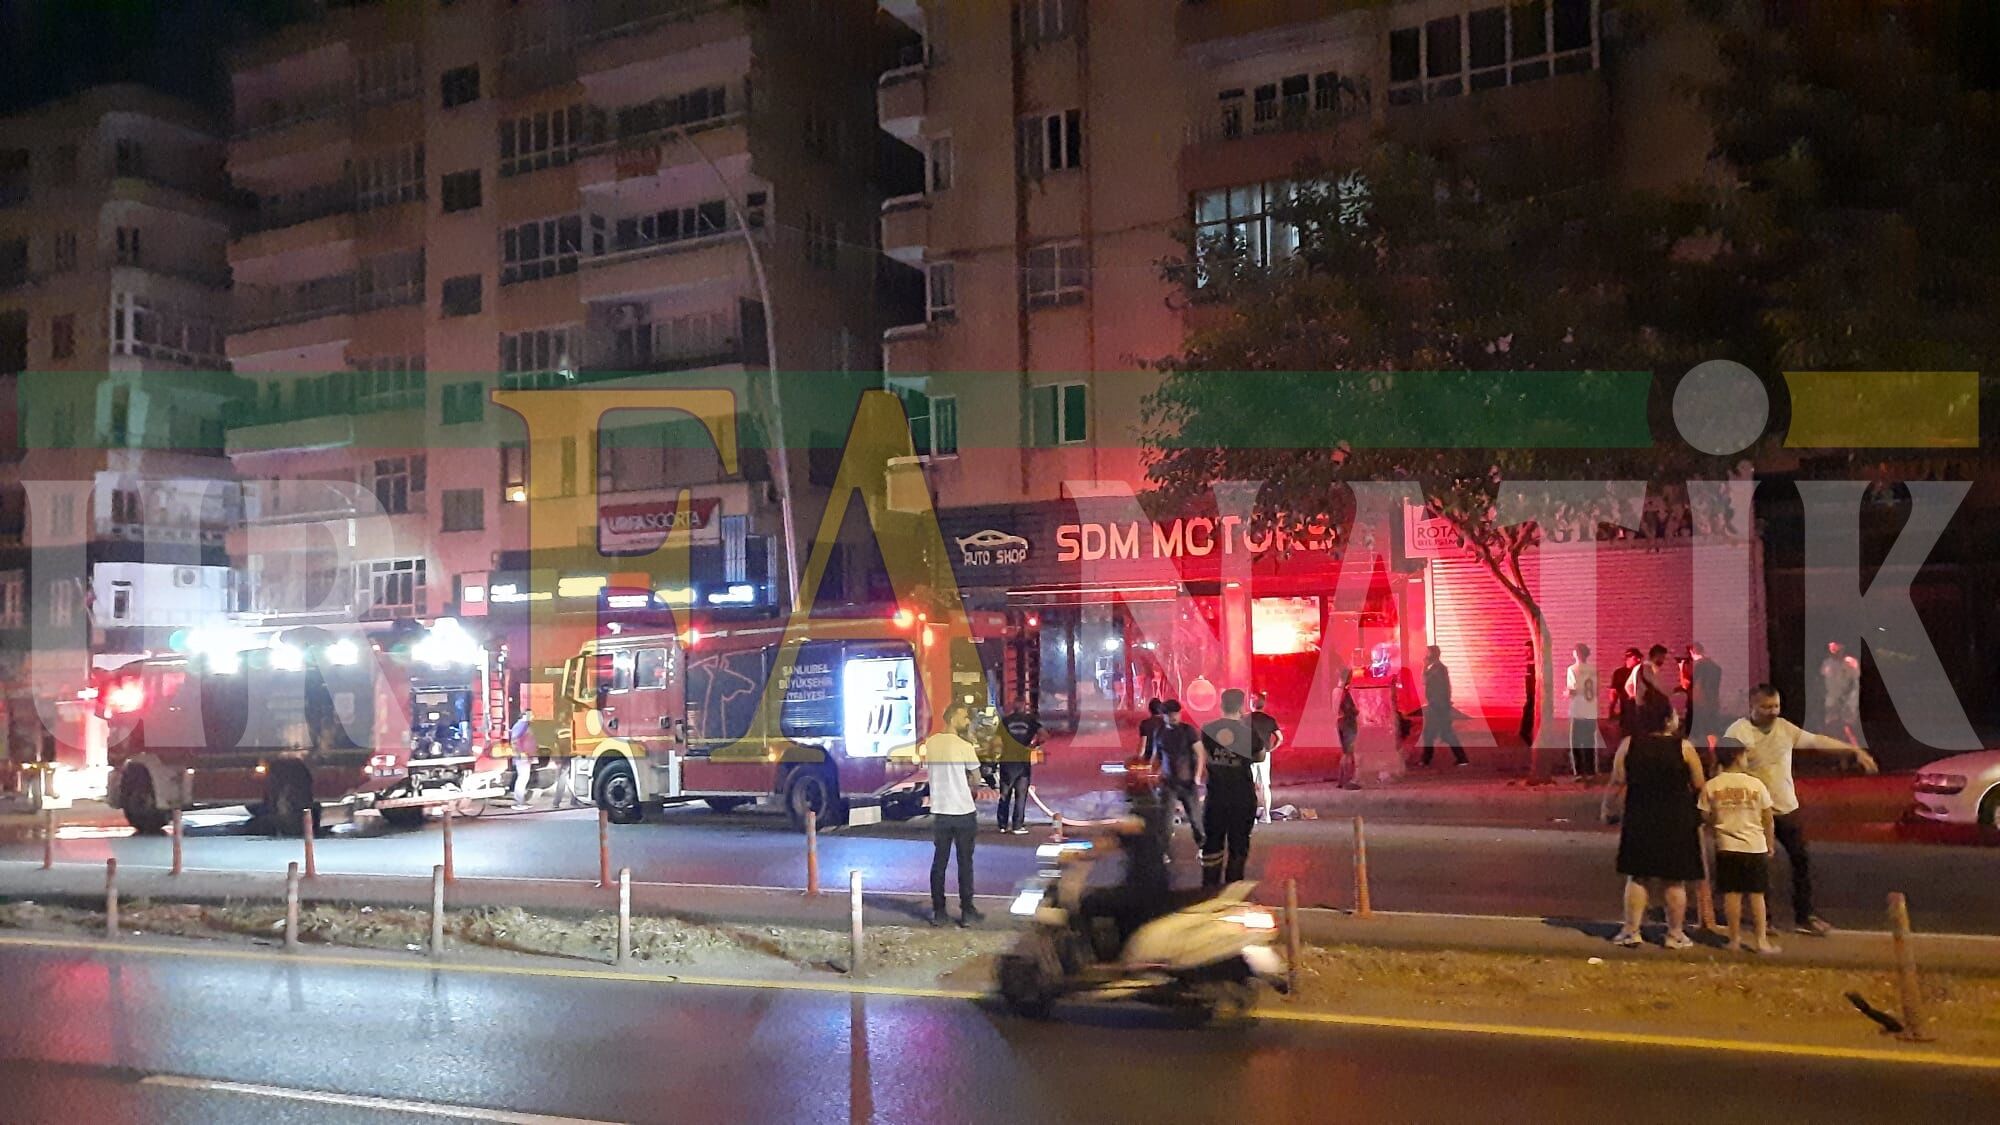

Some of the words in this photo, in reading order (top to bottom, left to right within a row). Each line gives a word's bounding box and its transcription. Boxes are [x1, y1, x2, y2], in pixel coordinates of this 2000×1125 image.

[1056, 521, 1139, 561] SDM
[1417, 525, 1459, 539] ROTA
[964, 550, 991, 566] AUTO
[996, 548, 1026, 564] SHOP
